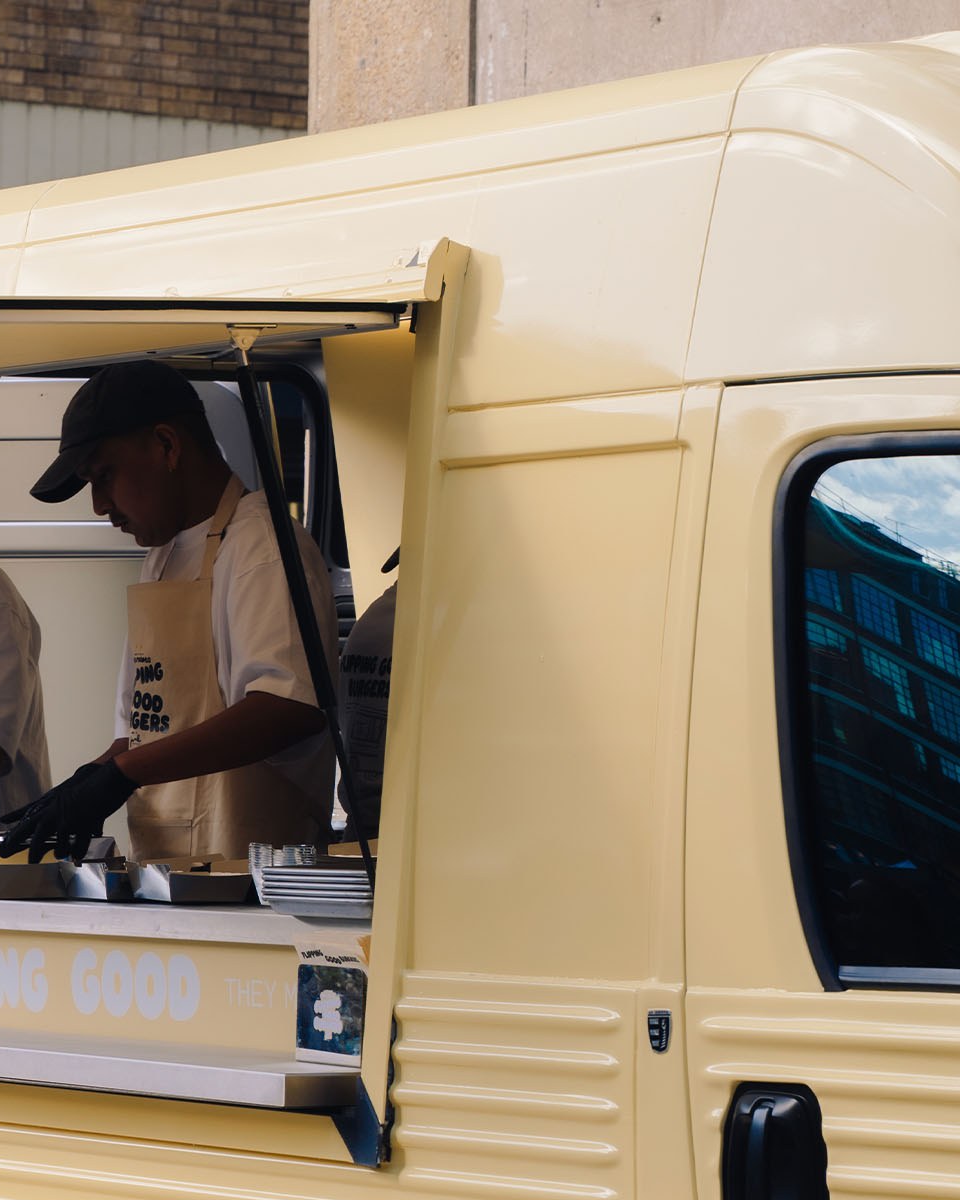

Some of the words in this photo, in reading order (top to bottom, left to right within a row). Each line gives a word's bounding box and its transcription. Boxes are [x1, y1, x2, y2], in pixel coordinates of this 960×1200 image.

[133, 690, 163, 713] OOD
[130, 711, 169, 733] GERS
[70, 946, 200, 1022] GOOD
[224, 978, 277, 1009] THEY
